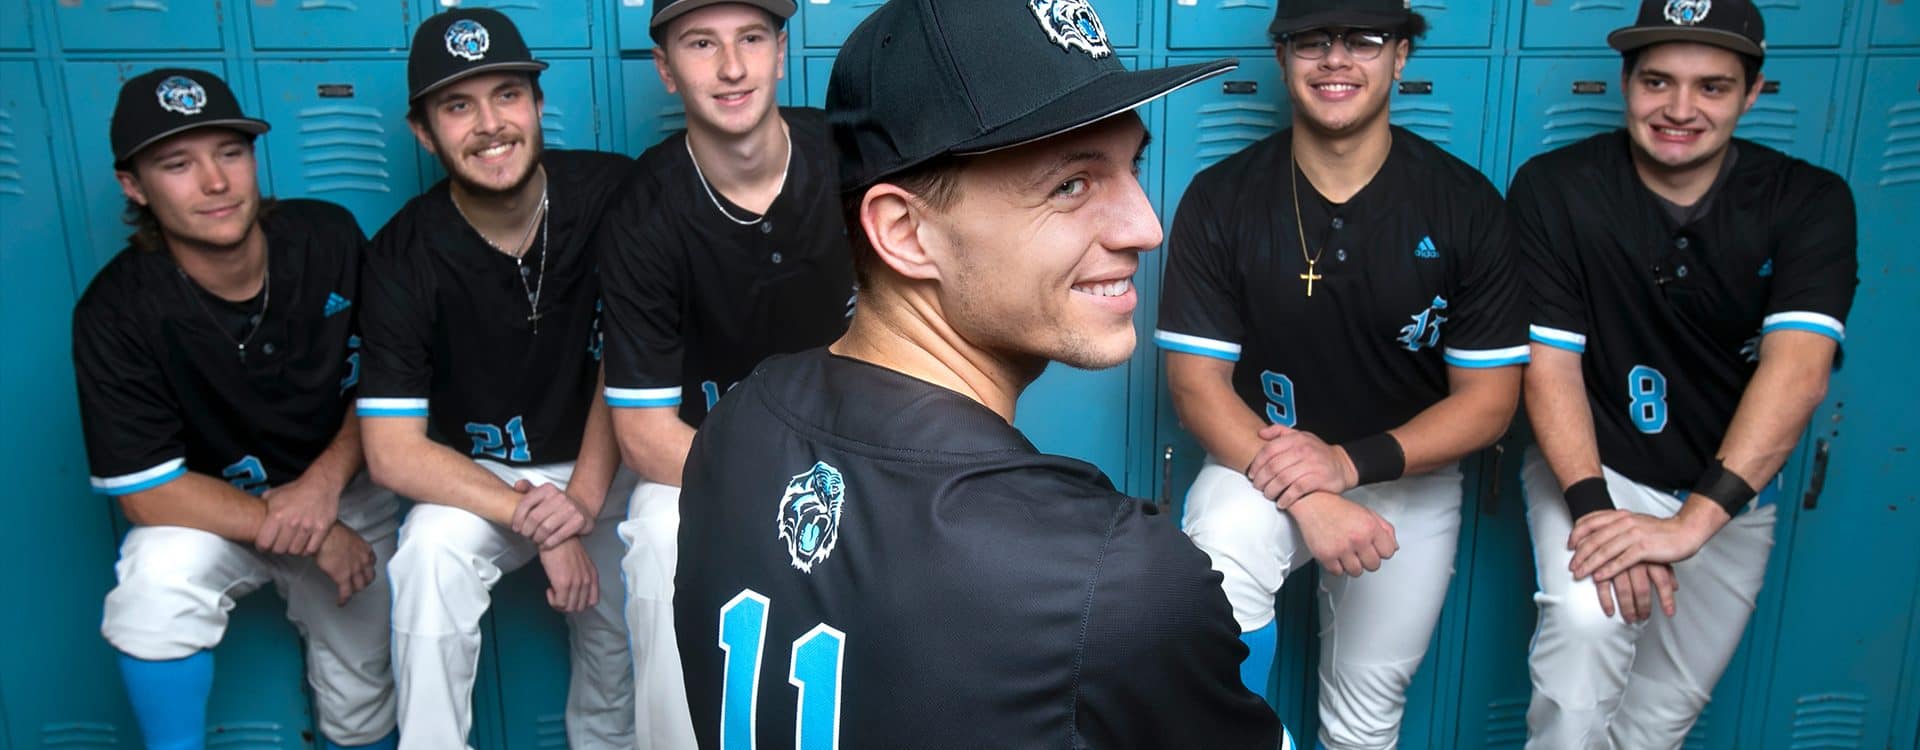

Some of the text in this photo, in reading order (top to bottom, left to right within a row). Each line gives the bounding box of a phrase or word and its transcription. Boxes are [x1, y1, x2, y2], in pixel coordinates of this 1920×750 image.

[1260, 369, 1297, 428] 9
[1628, 364, 1668, 434] 8
[464, 415, 531, 461] 21
[718, 588, 846, 750] 11
